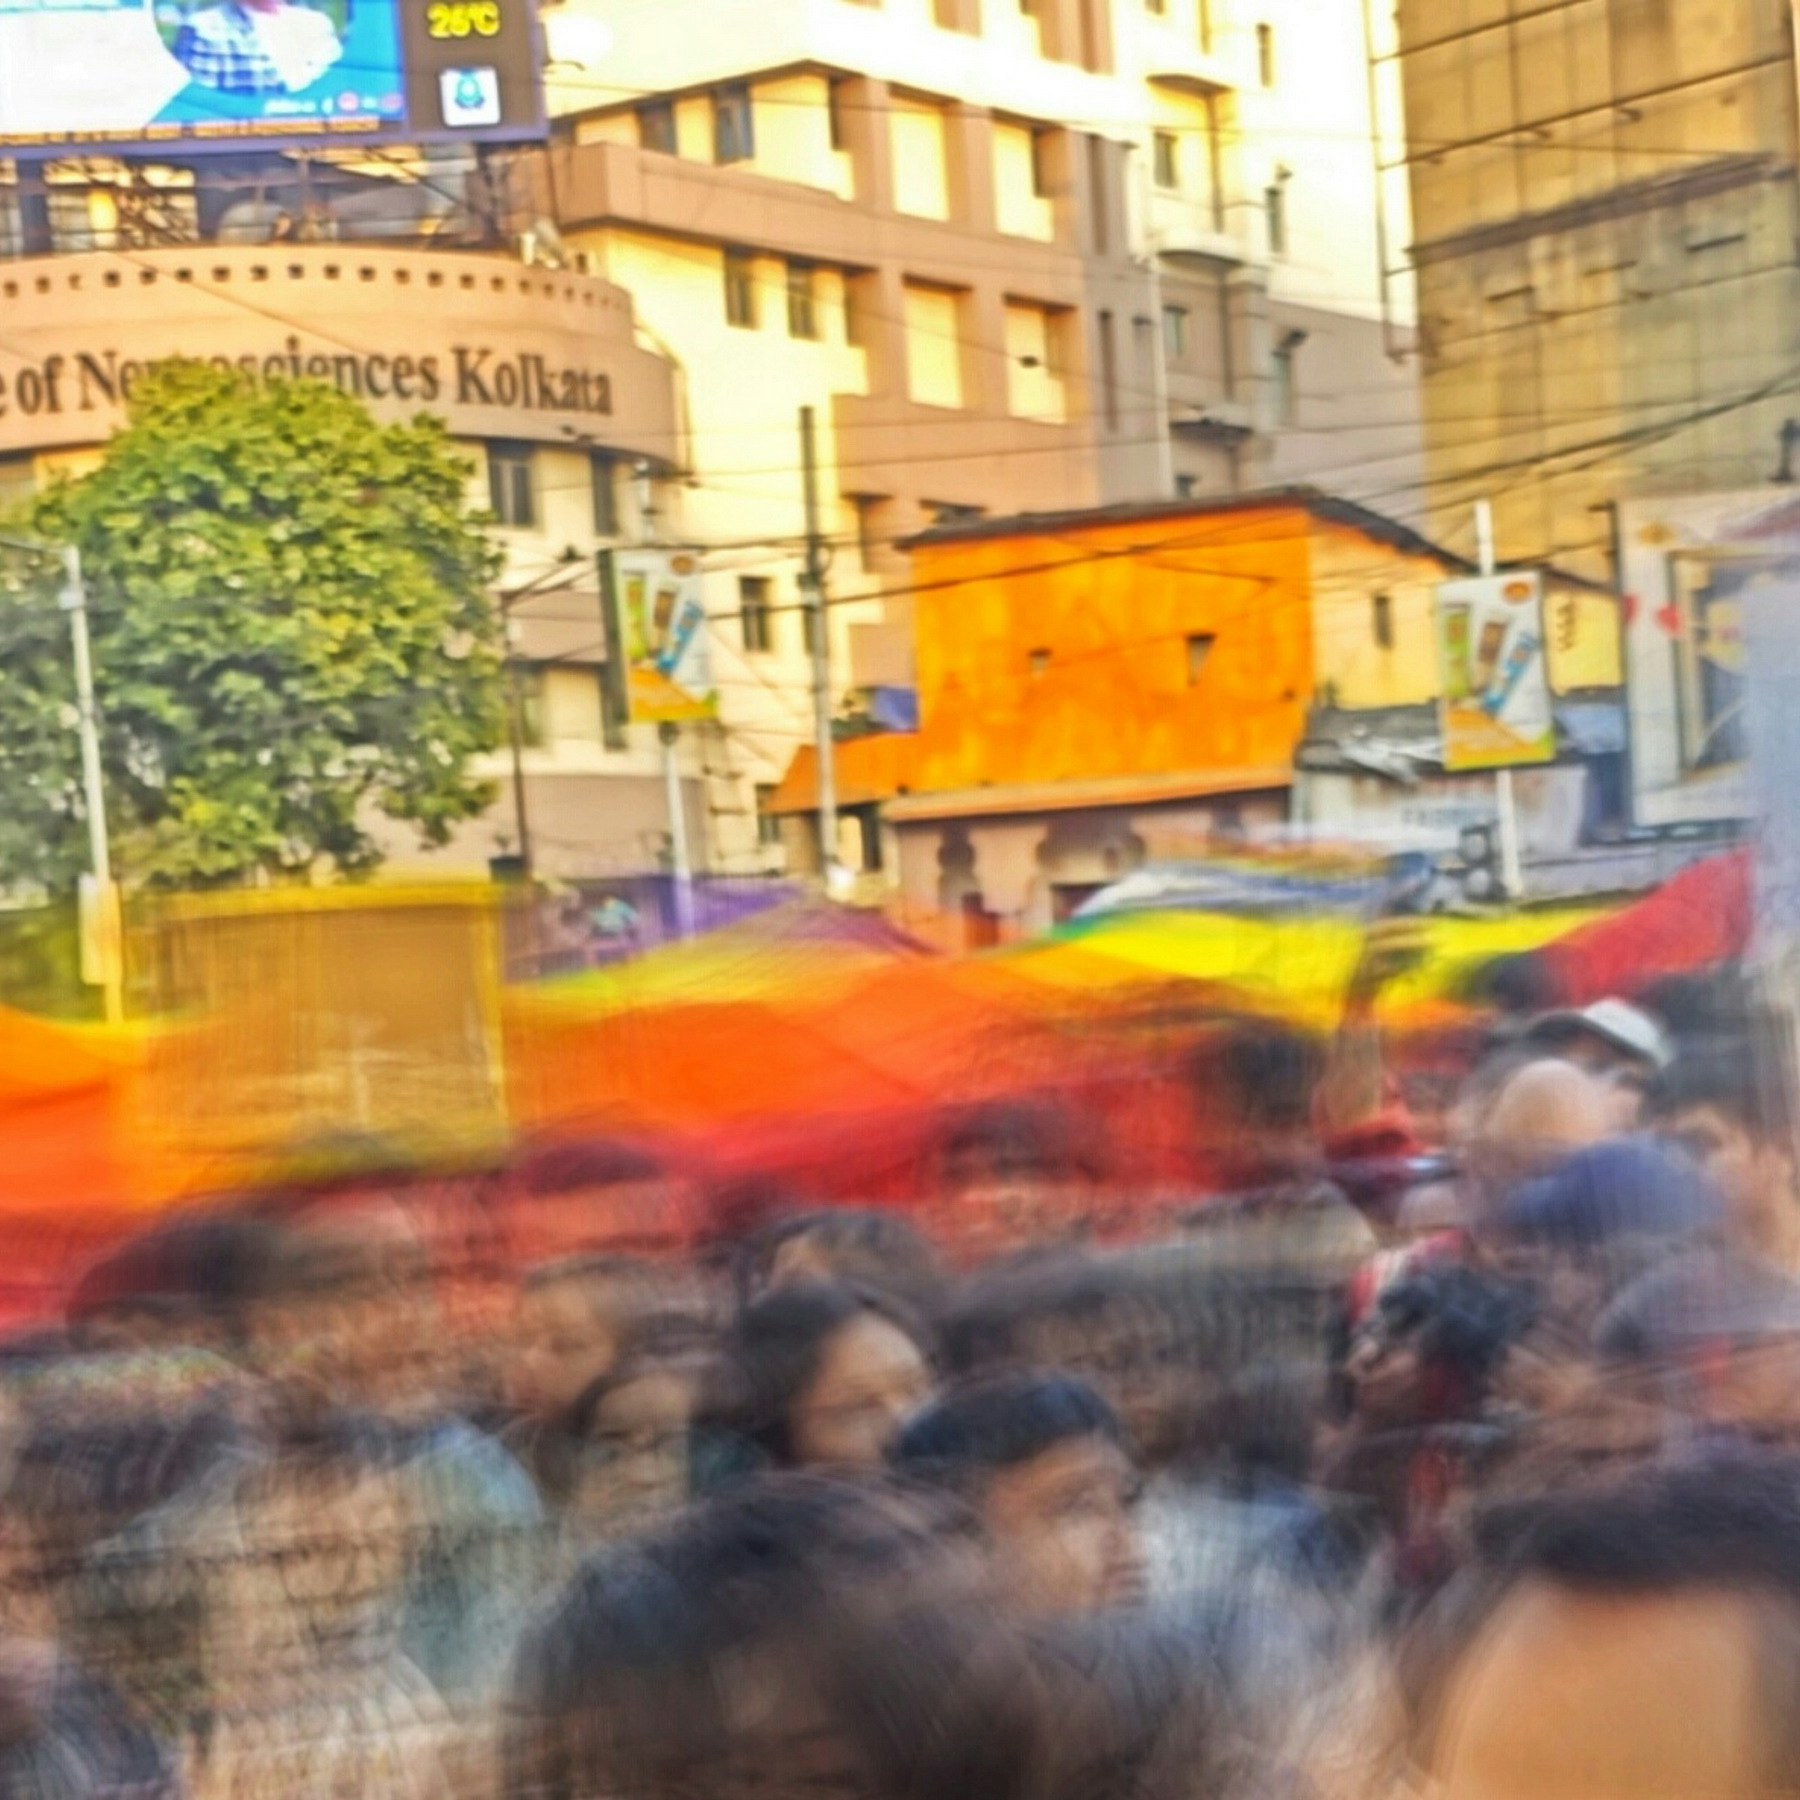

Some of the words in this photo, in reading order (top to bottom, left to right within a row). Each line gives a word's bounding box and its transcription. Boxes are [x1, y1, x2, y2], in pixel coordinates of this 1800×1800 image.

[15, 353, 66, 416] of
[74, 335, 440, 412] Nesciences
[449, 345, 613, 416] Kolkata
